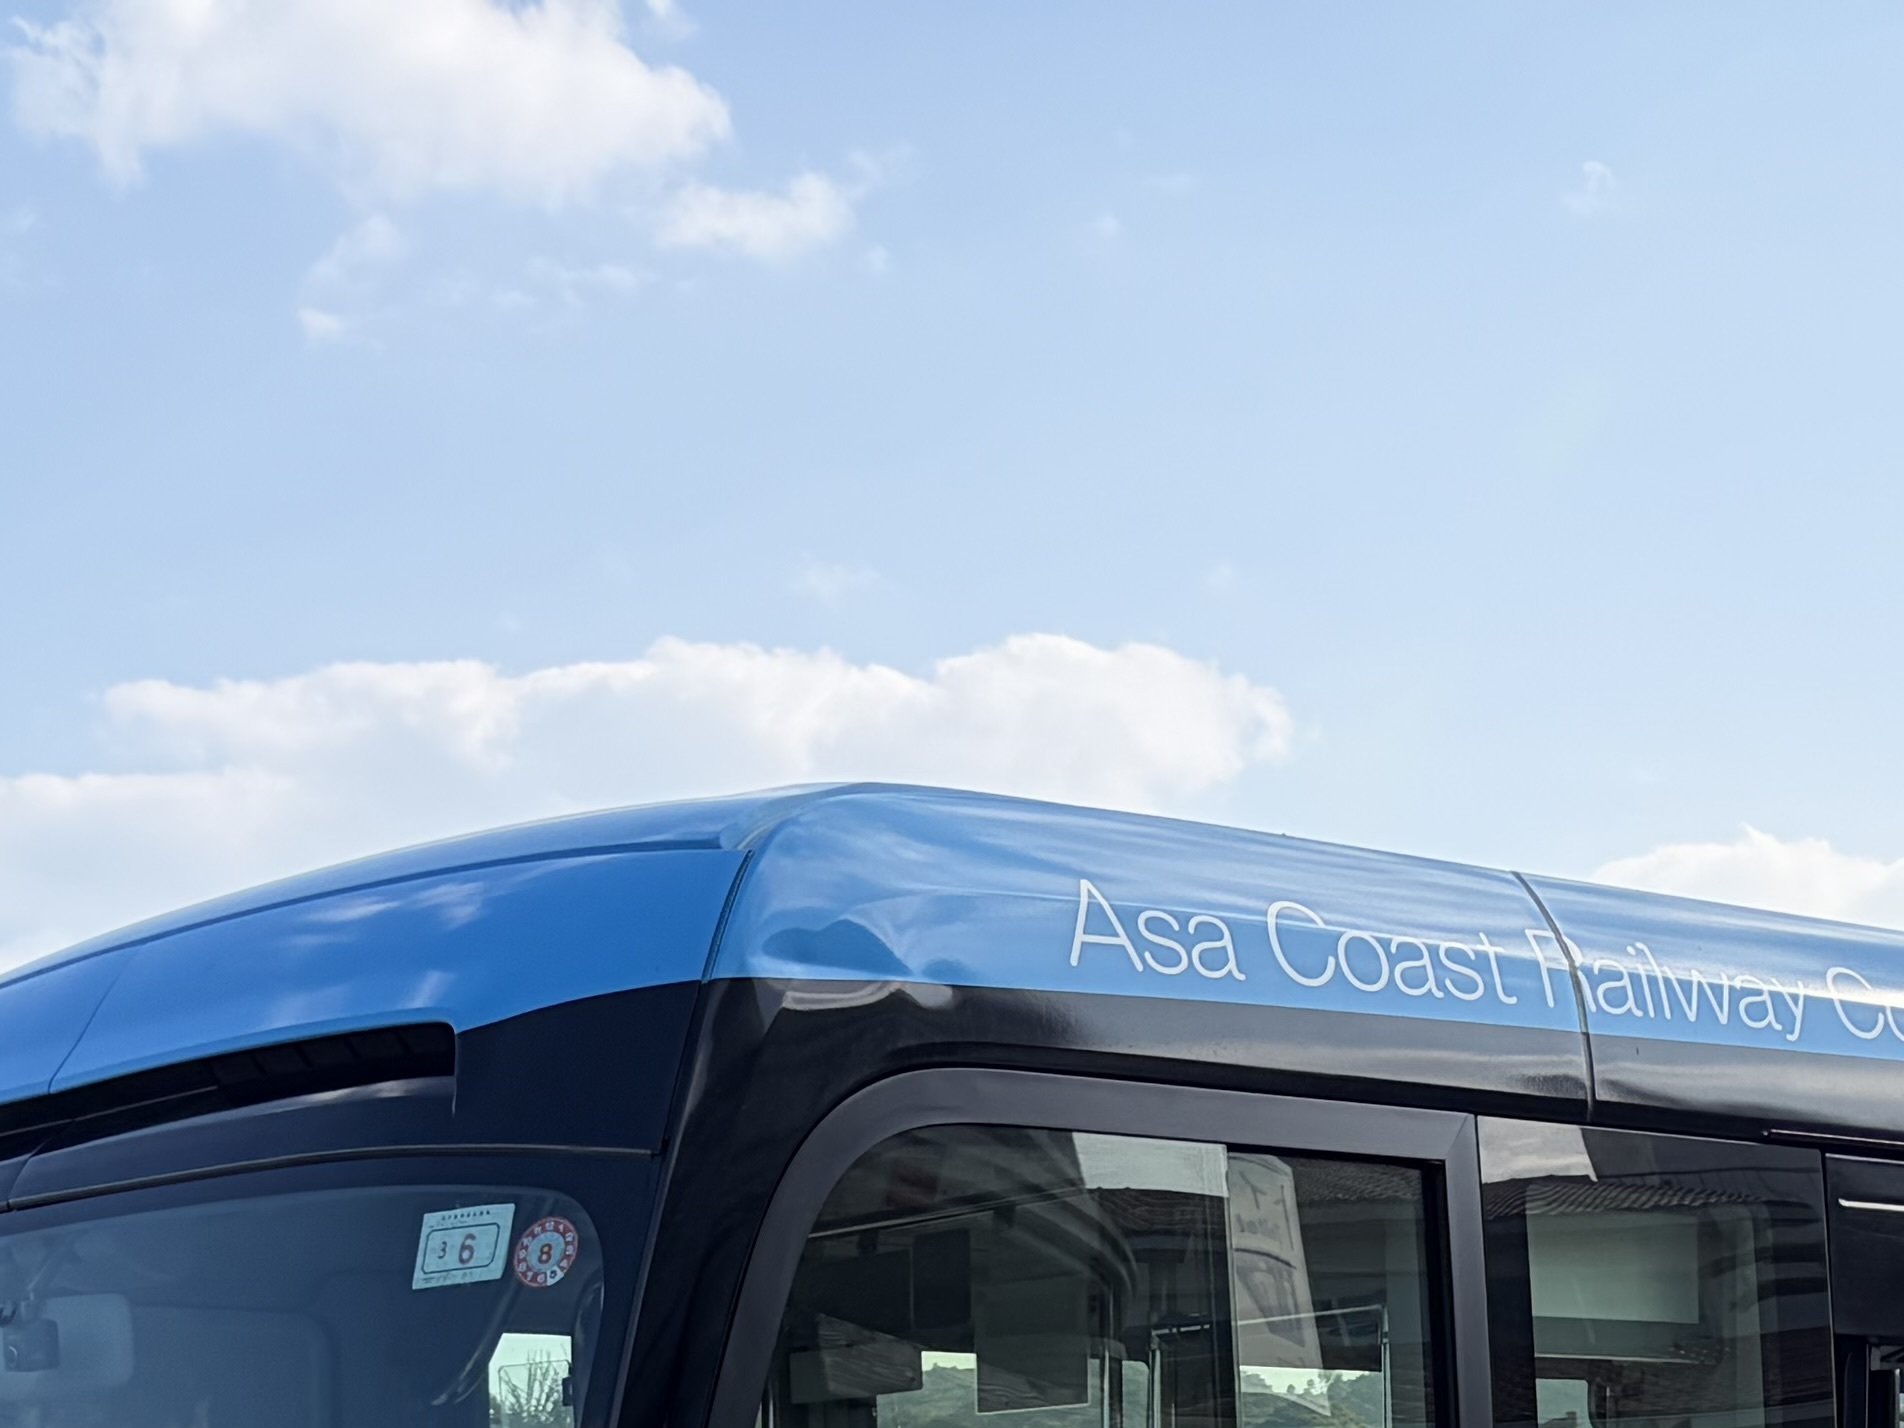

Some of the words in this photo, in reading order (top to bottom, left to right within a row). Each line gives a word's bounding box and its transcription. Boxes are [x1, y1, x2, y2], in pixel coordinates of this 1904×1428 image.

[1069, 878, 1247, 982] Asa
[1266, 901, 1518, 1004] Coast
[1525, 927, 1806, 1041] Railway
[458, 1232, 478, 1265] 6
[538, 1243, 553, 1264] 8
